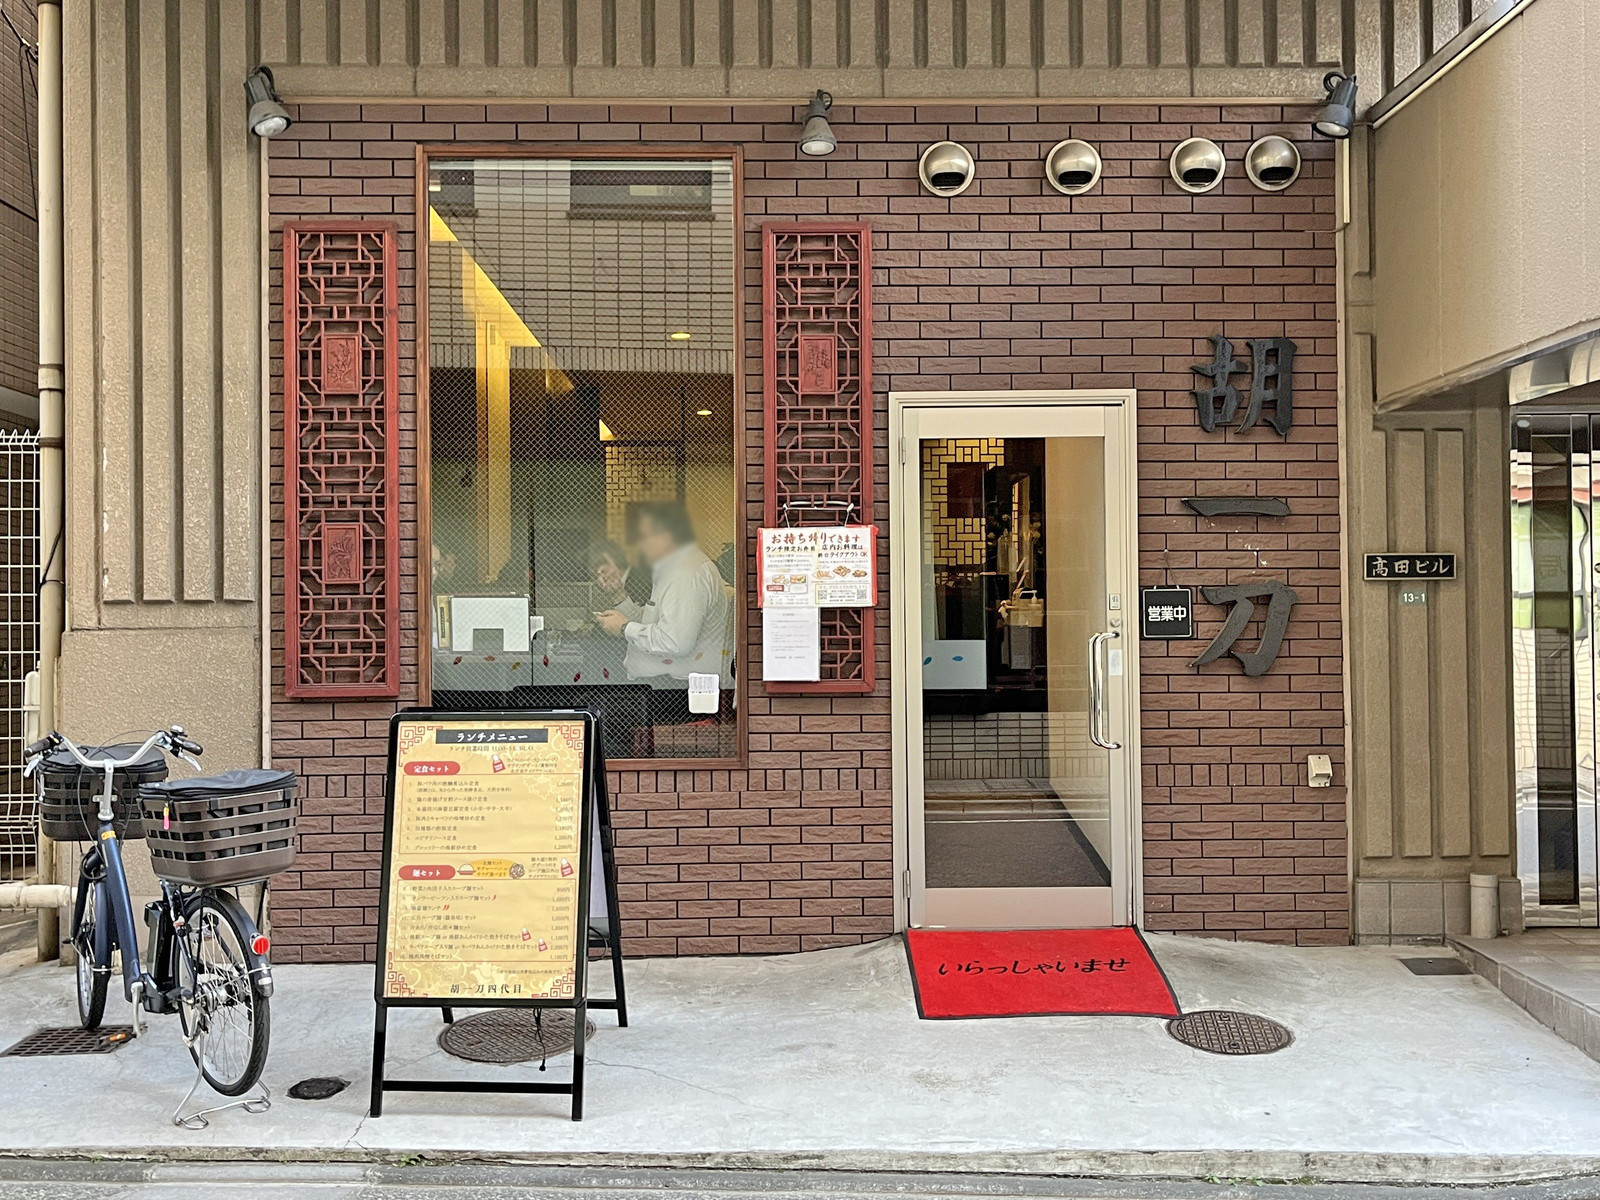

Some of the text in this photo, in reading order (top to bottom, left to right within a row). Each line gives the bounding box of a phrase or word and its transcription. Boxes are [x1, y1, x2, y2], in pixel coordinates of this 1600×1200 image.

[1403, 593, 1426, 602] 13-1
[1147, 605, 1187, 622] 営業中
[457, 732, 528, 742] ランチメニュー
[414, 765, 449, 773] 定食セット
[412, 869, 440, 878] 麺セット
[938, 958, 1131, 976] いらっしゃいませ
[450, 984, 522, 994] 胡一刀四代目
